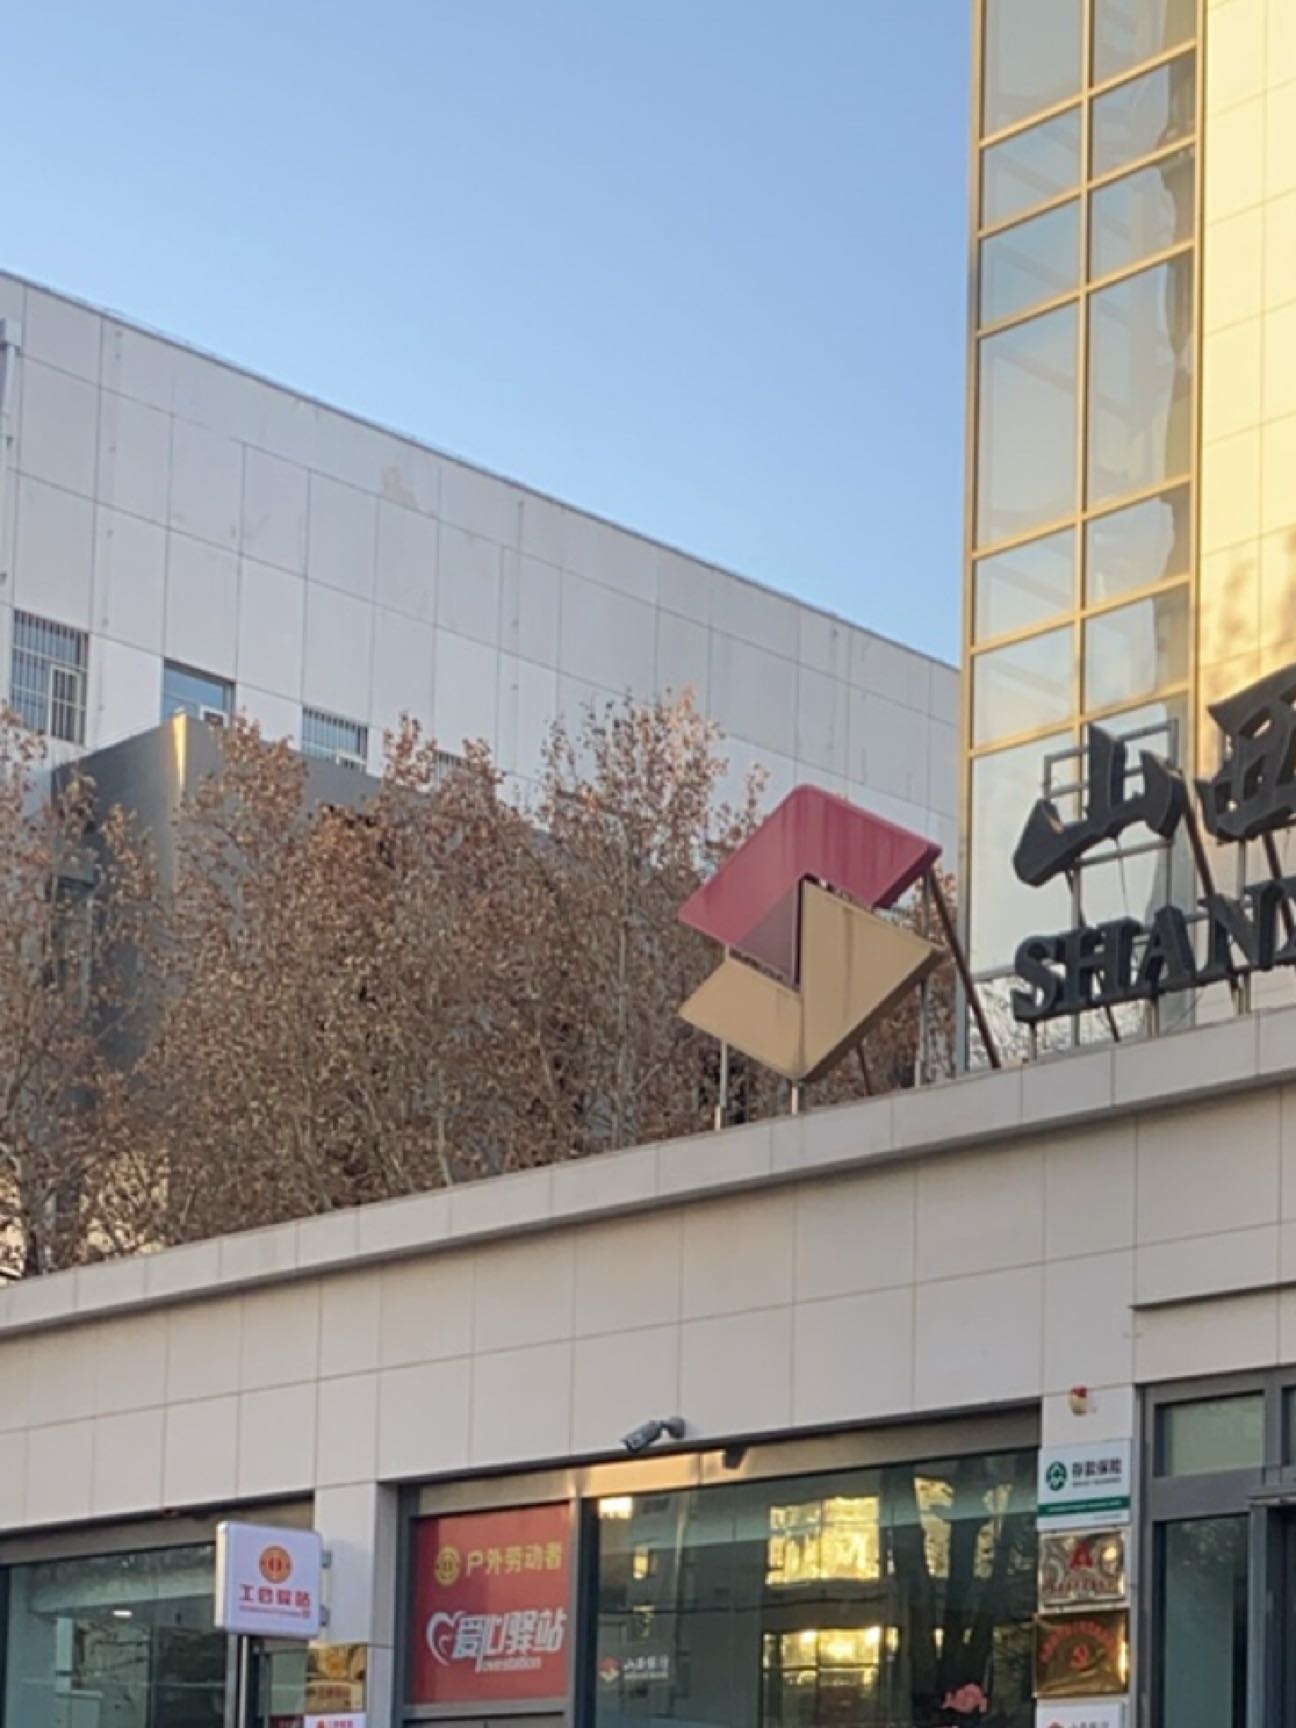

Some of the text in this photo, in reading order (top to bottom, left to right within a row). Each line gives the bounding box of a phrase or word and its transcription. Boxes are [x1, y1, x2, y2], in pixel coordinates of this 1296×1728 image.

[466, 1541, 563, 1577] 户外劳动者
